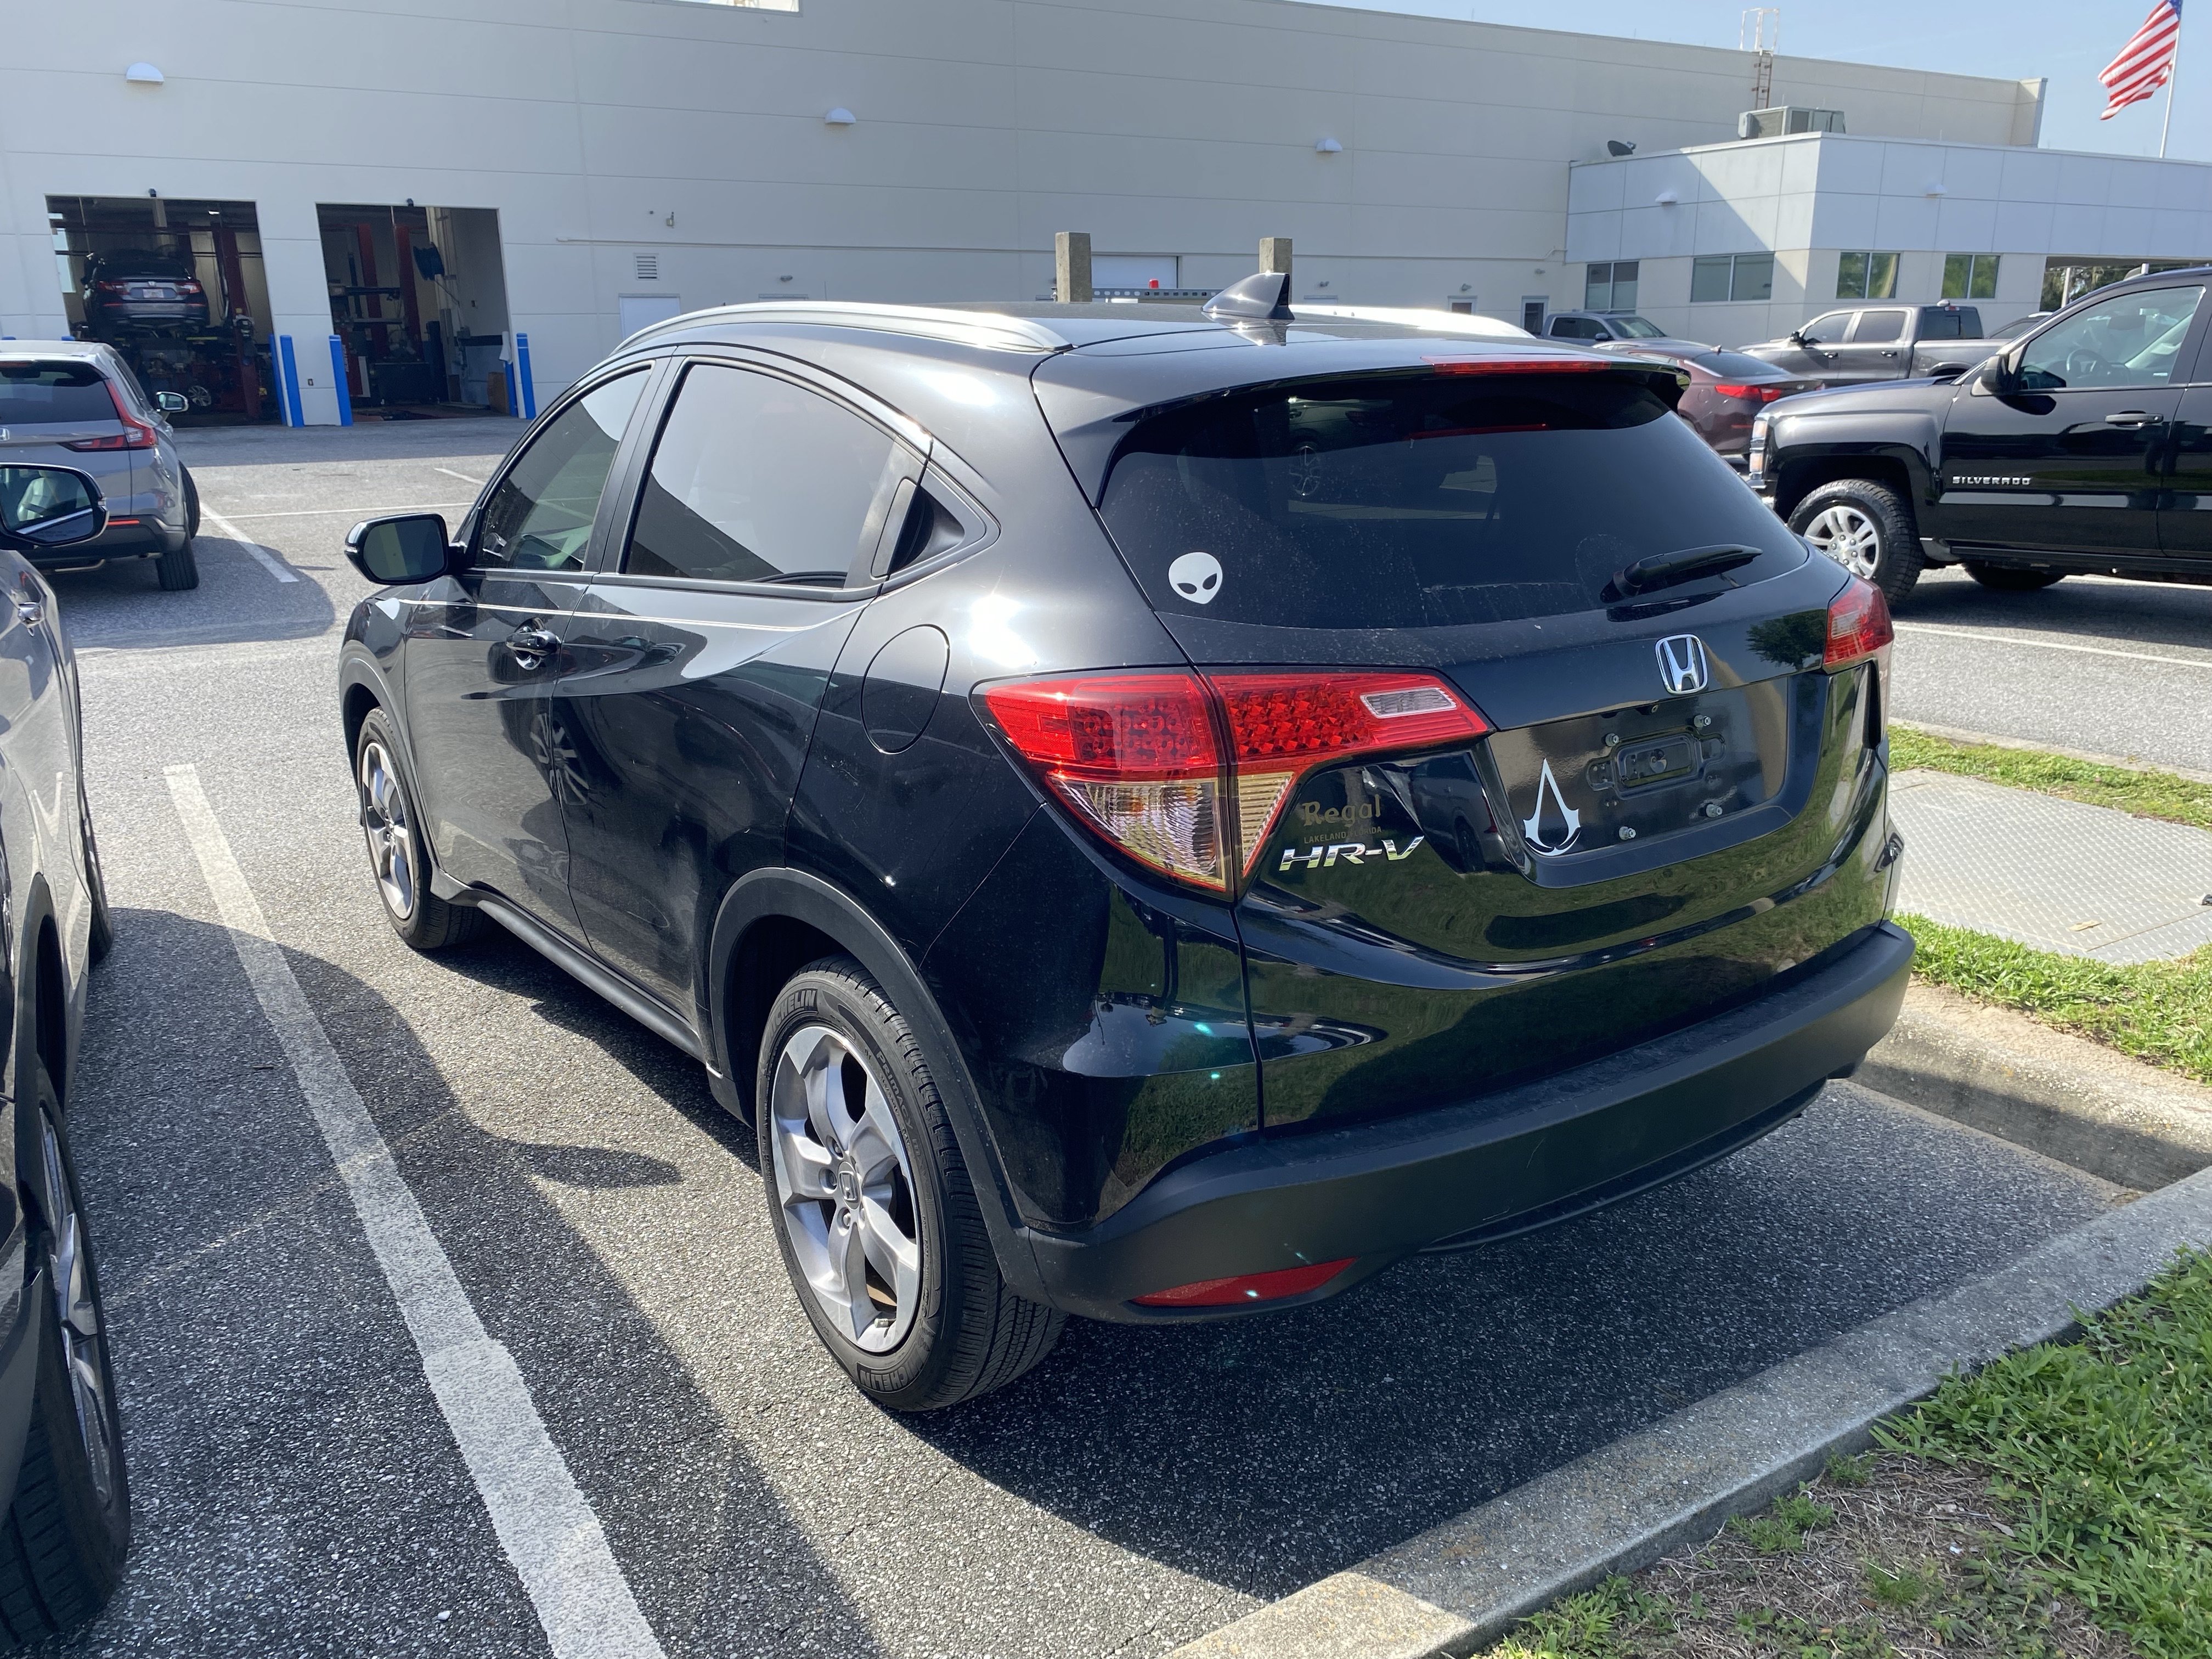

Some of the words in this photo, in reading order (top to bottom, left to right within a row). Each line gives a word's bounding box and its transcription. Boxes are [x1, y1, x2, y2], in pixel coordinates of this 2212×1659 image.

[1952, 476, 2031, 485] SILVERADO
[1302, 794, 1381, 827] Regal
[1304, 831, 1346, 844] LAKELAND
[1279, 835, 1425, 871] HR-V
